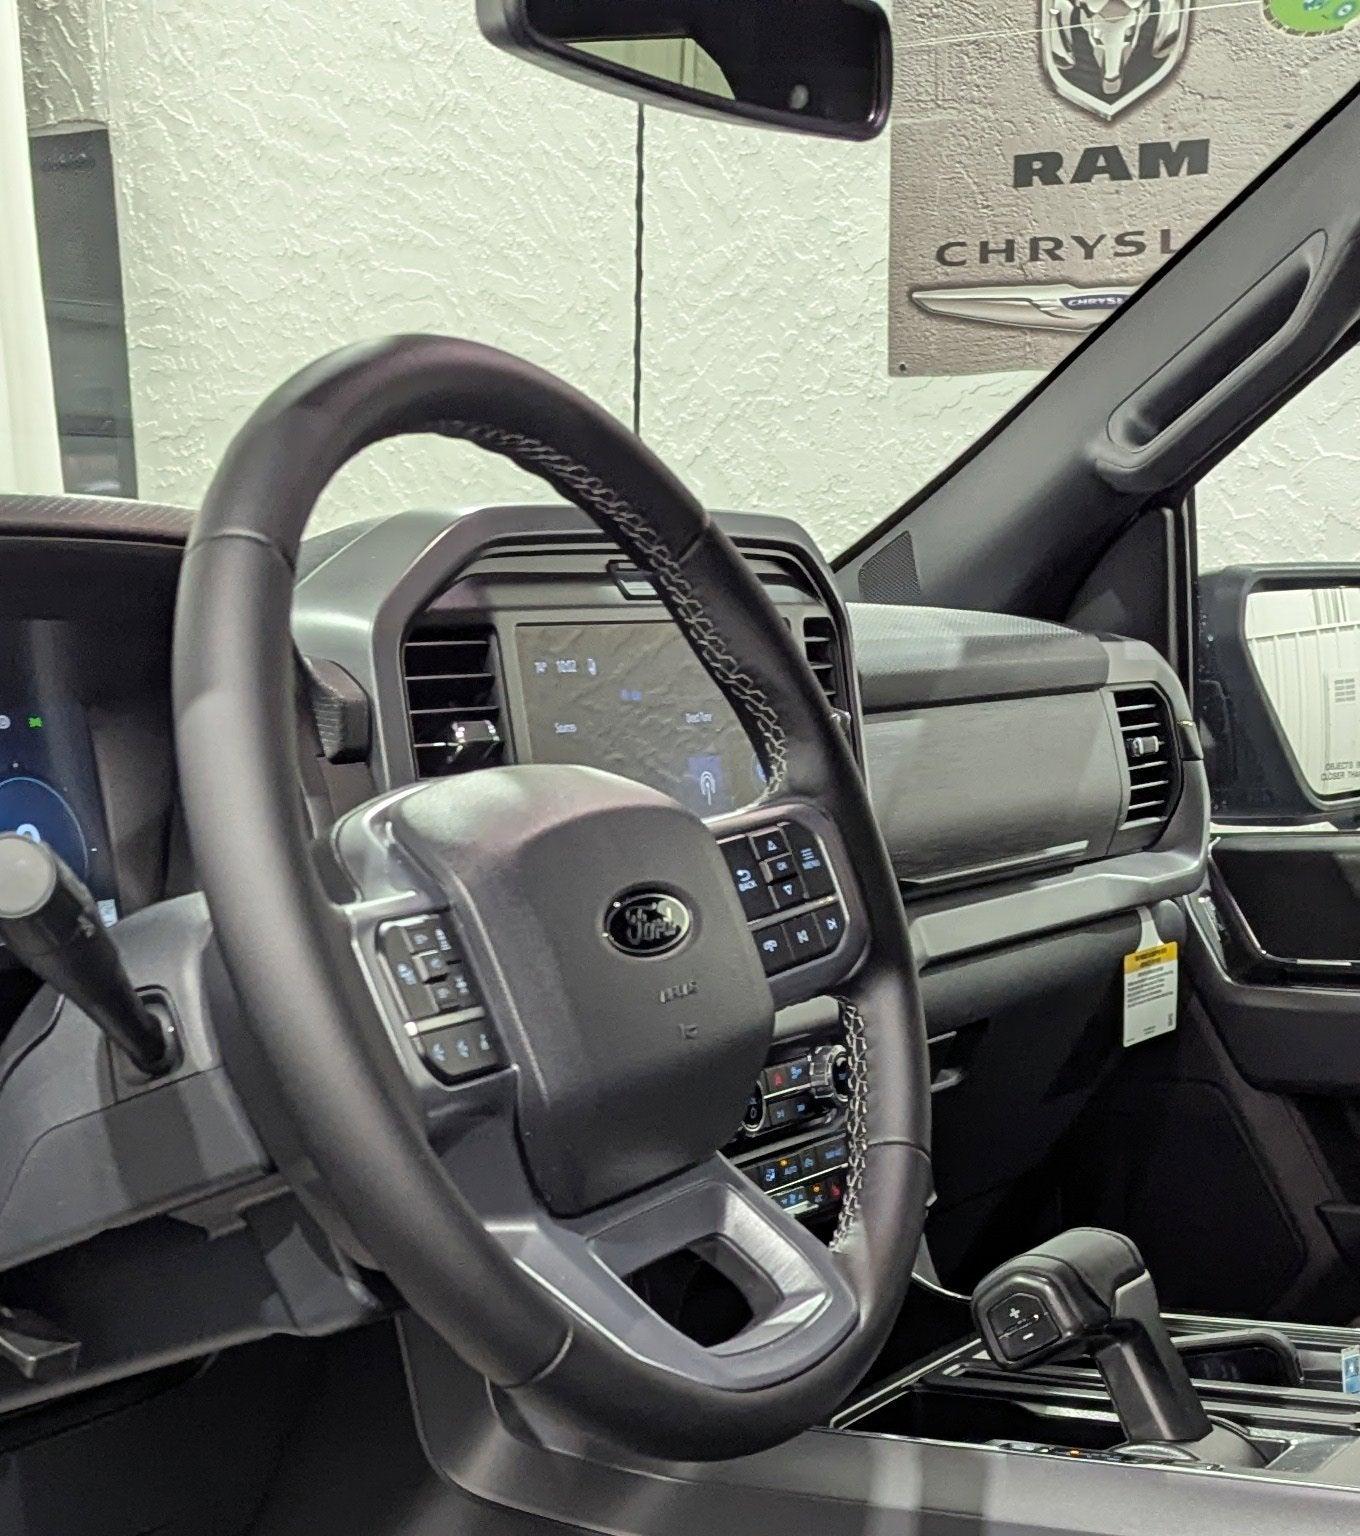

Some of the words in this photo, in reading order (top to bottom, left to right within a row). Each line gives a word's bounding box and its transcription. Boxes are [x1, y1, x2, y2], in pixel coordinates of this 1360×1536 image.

[1013, 138, 1210, 188] RAM
[934, 228, 1181, 267] CHRYSL
[1325, 761, 1354, 771] OBJECTS
[625, 903, 677, 946] Ford
